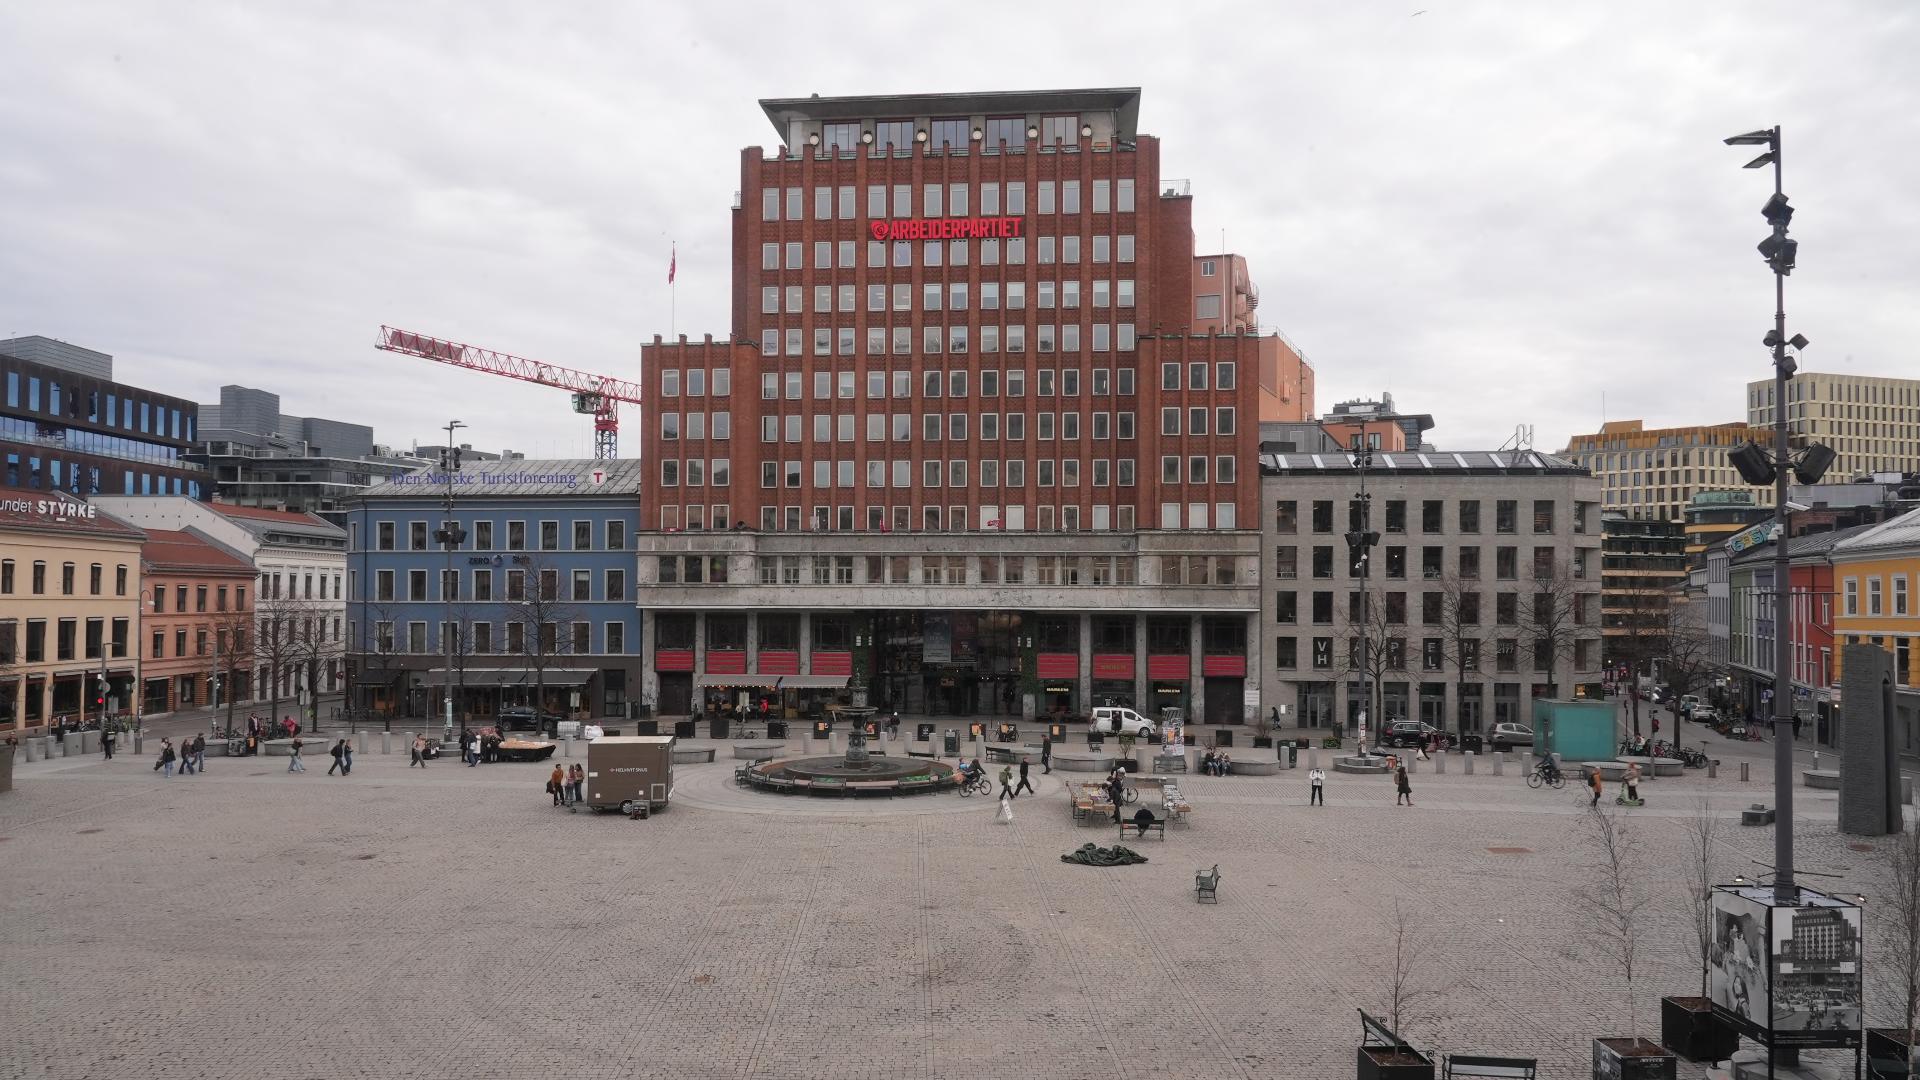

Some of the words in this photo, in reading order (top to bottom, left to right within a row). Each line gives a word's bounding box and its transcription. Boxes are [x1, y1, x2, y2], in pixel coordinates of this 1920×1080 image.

[890, 217, 1022, 240] ARBEIDERPARTIET
[392, 470, 420, 485] Den
[426, 470, 475, 485] Norske
[37, 498, 96, 521] STYRKE
